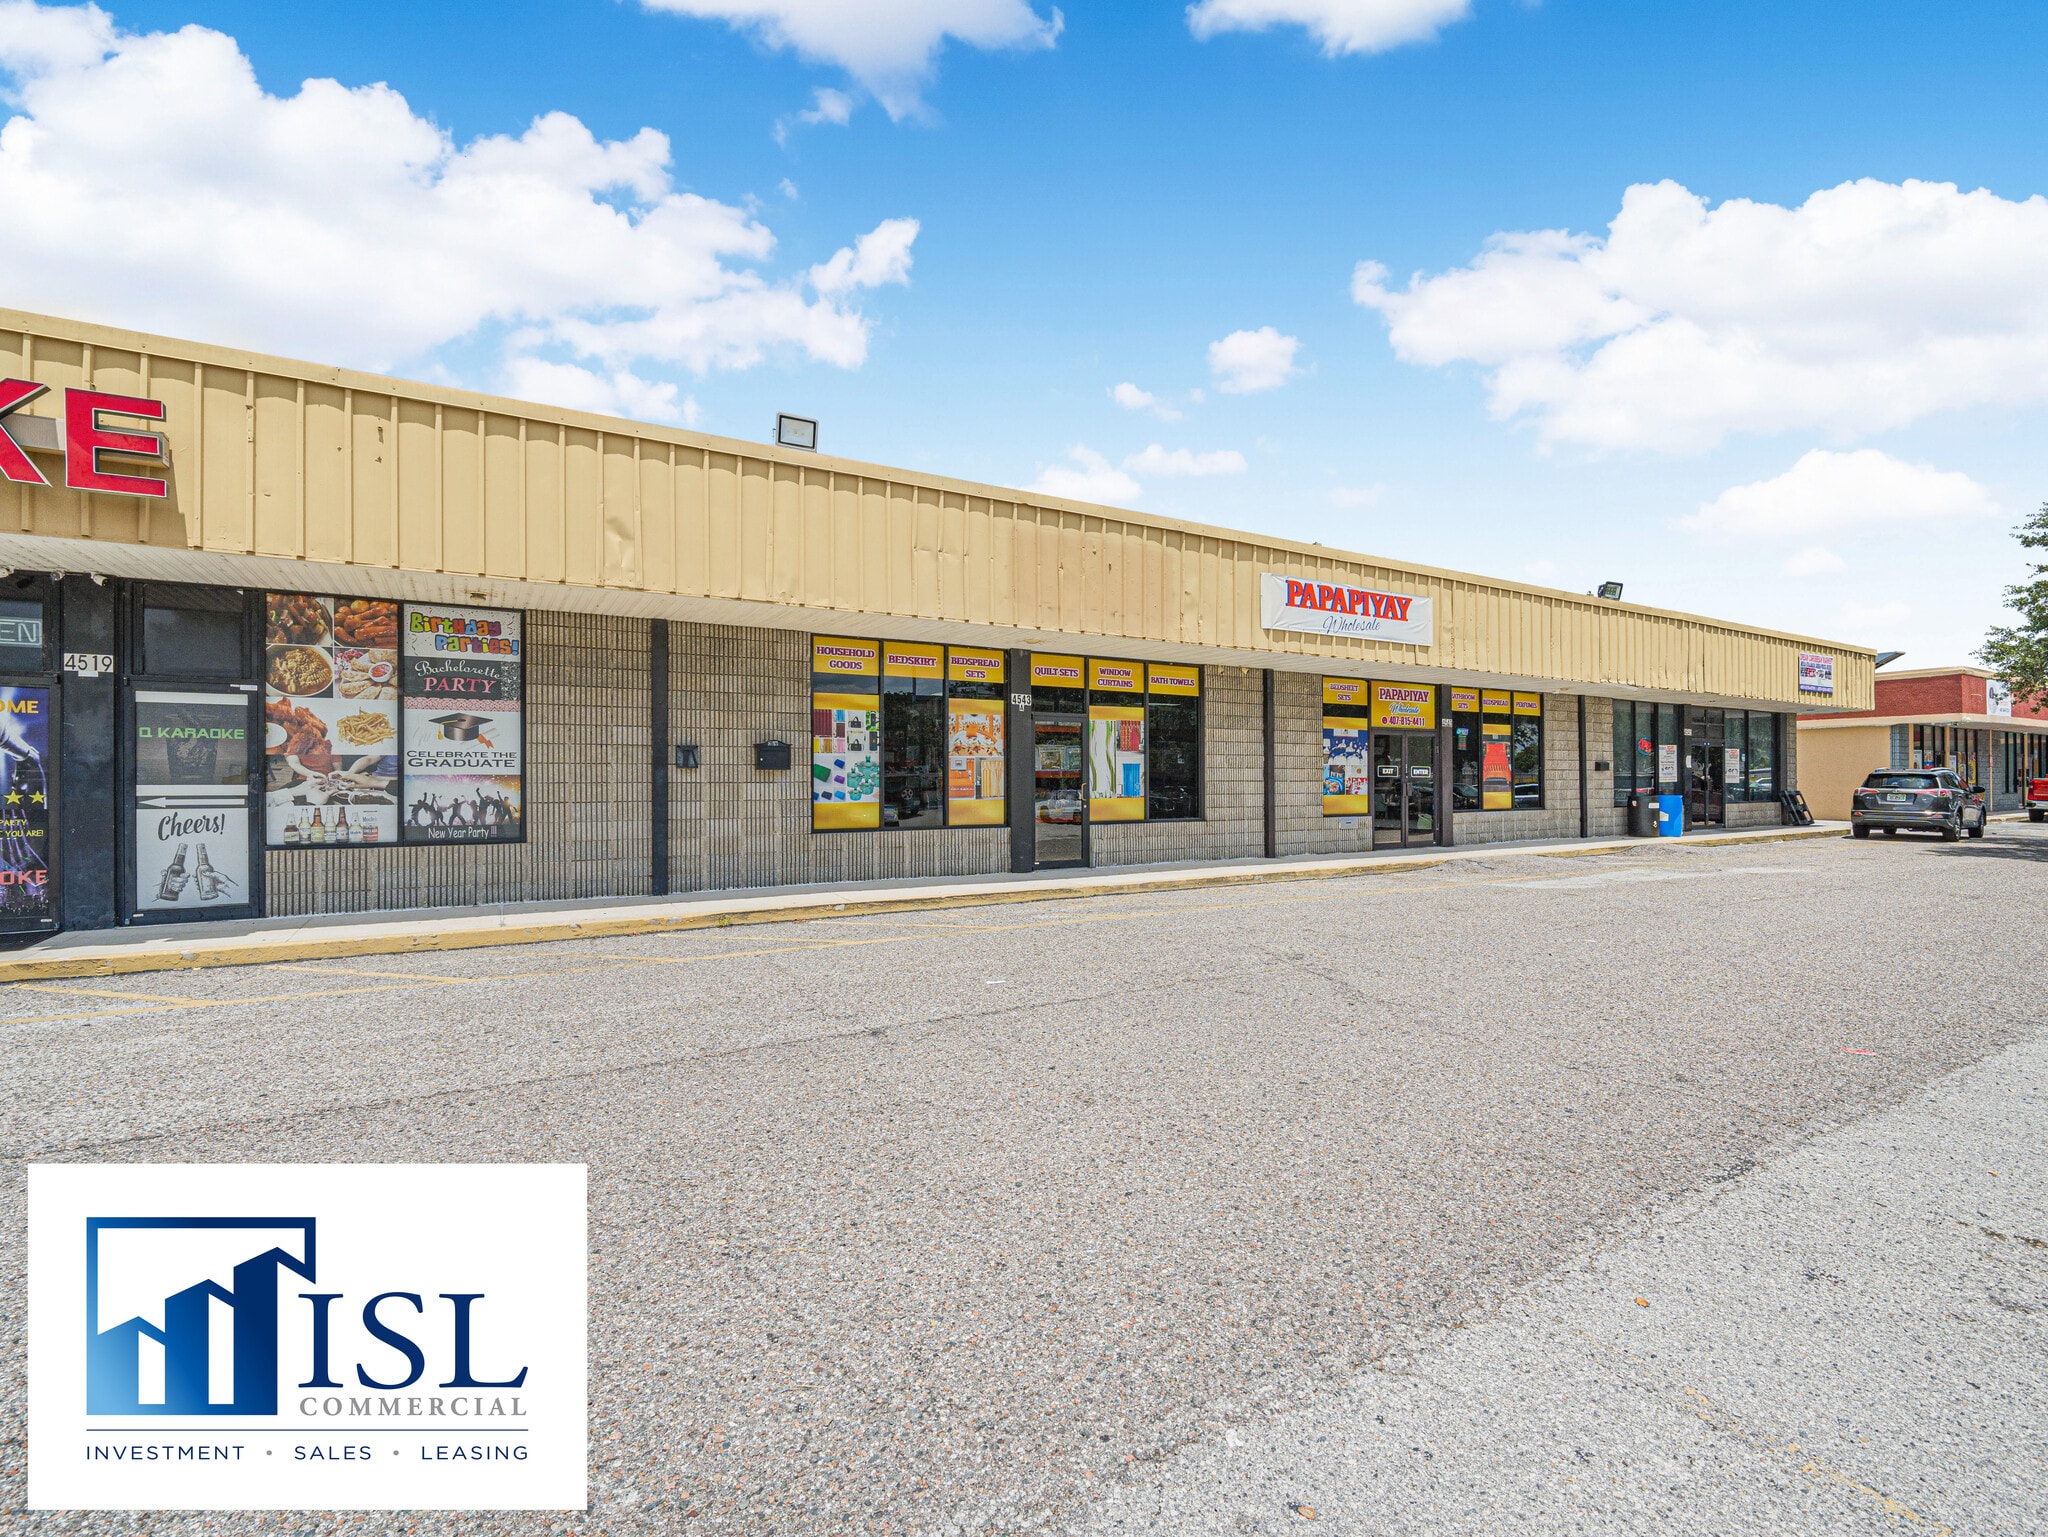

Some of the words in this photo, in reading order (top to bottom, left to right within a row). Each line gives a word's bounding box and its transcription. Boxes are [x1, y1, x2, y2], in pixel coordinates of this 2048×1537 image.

[1285, 579, 1413, 622] PAPAPIYAY
[1322, 615, 1381, 634] Wholesale
[435, 634, 520, 656] Parties!
[816, 646, 875, 658] HOUSEHOLD
[64, 654, 113, 672] 4519
[829, 660, 863, 670] GOODS
[887, 654, 937, 667] BEDSKIRT
[950, 656, 1001, 668] BEDSPREAD
[414, 660, 501, 679] Bachelorette
[965, 669, 986, 679] SETS
[1034, 666, 1059, 677] QUILT
[1059, 668, 1080, 678] SETS
[1099, 667, 1132, 677] WINDOW
[423, 677, 497, 694] PARTY
[1097, 678, 1134, 688] CURTAINS
[1150, 676, 1169, 686] BATH
[1169, 677, 1196, 687] TOWELS
[1012, 694, 1031, 705] 4543
[1337, 693, 1352, 701] SETS
[1378, 687, 1430, 703] PAPAPIYAY
[1389, 716, 1425, 726] 407-815-4411
[157, 727, 245, 740] KARAOKE
[406, 750, 489, 758] CELEBRATE
[491, 751, 518, 759] THE
[407, 758, 516, 768] GRADUATE
[157, 811, 226, 842] Cheers!
[428, 827, 446, 839] New
[447, 827, 467, 838] Year
[468, 826, 489, 839] Party
[5, 829, 24, 838] YOU
[26, 829, 44, 837] ARE!
